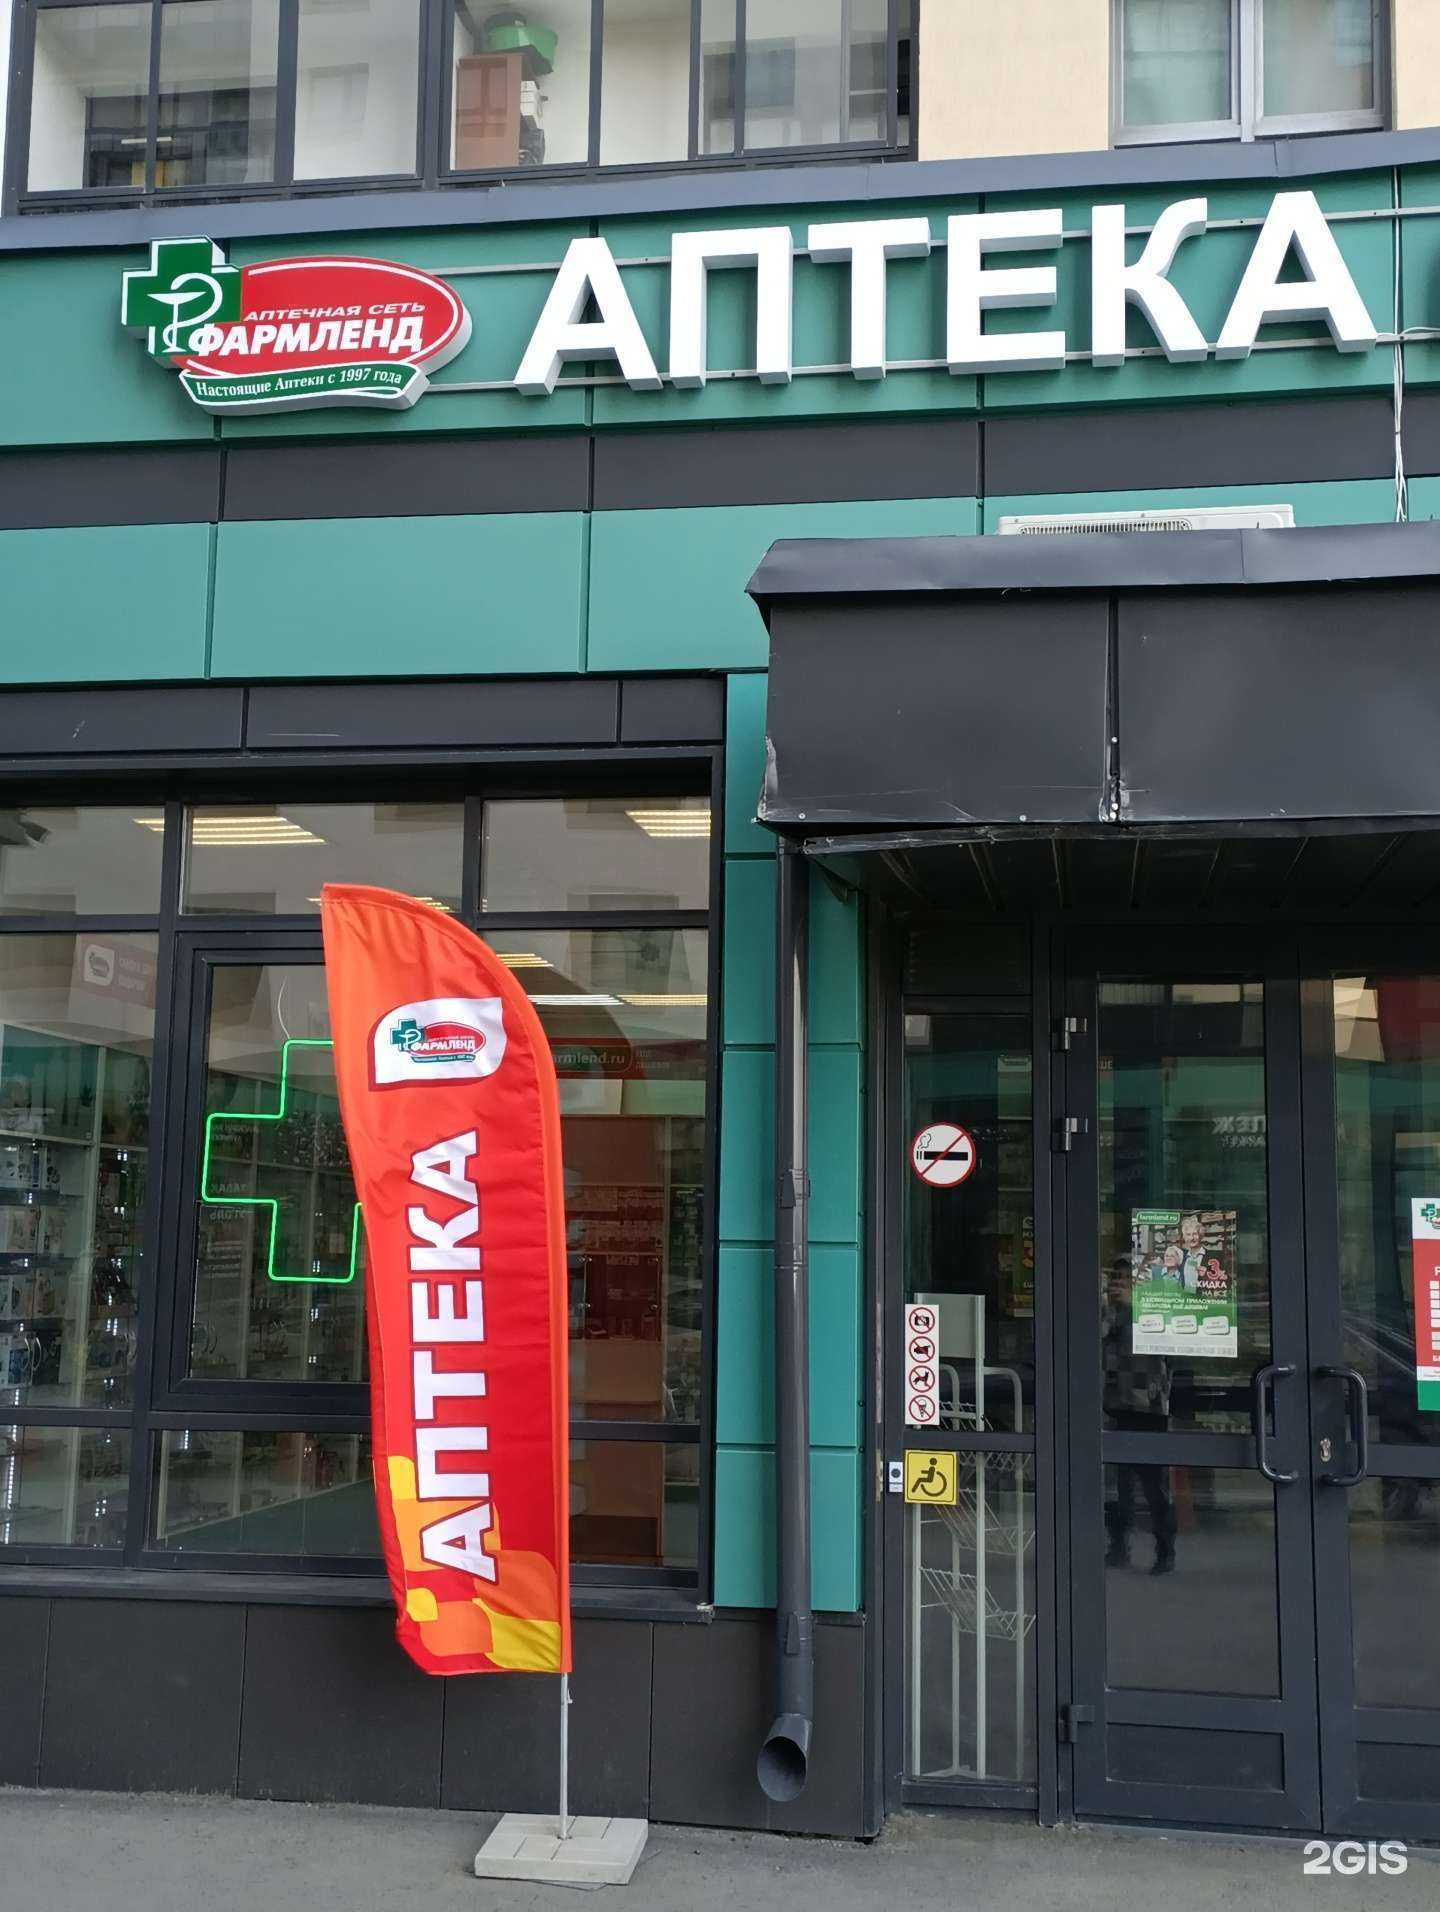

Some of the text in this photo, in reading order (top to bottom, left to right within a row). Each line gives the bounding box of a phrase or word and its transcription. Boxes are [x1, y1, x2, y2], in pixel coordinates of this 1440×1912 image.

[513, 190, 1377, 395] АПТЕКА
[243, 302, 426, 321] АПТЕЧНАЯ СЕТЬ
[188, 316, 424, 356] ФАРМЛЕНД
[196, 368, 402, 397] Настоящие Аптеки с 1997 года
[410, 1039, 476, 1052] ФАРМЛЕНД
[408, 1129, 496, 1583] АПТЕКА
